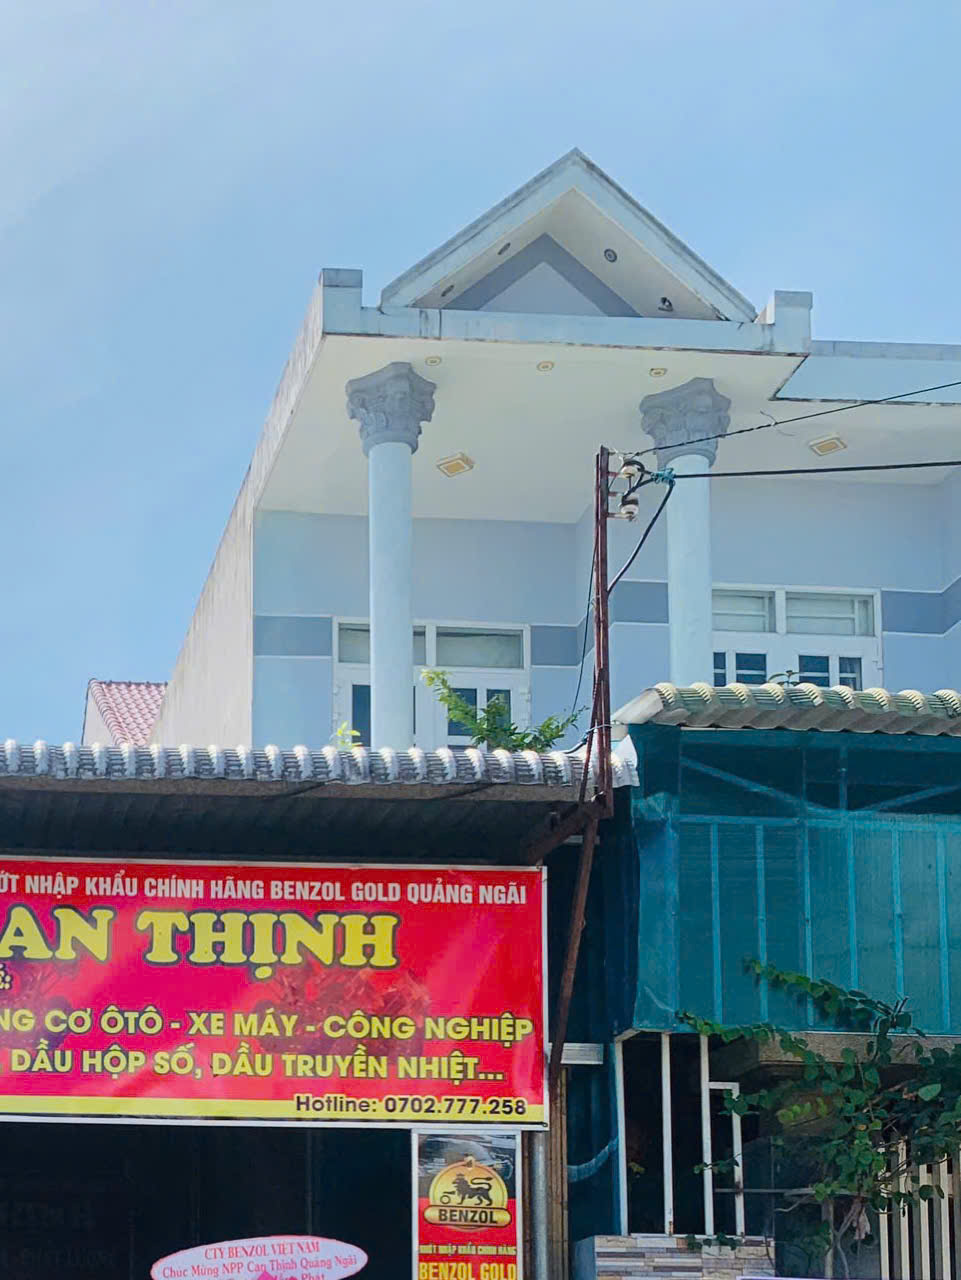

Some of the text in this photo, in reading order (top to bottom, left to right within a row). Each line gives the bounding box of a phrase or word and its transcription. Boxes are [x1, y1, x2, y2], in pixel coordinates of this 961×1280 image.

[25, 871, 79, 900] NHẬP
[85, 868, 138, 898] KHẨU
[144, 872, 204, 899] CHÍNH
[210, 876, 264, 900] HÃNG
[271, 880, 345, 901] BENZOL
[351, 881, 401, 902] GOLD
[407, 878, 473, 905] QUẢNG
[479, 882, 526, 904] NGÃI
[137, 909, 399, 979] THỊNH
[44, 1007, 92, 1034] CƠ
[100, 1006, 163, 1035] ÔTÔ
[188, 1012, 224, 1036] XE
[234, 1008, 298, 1037] MÁY
[323, 1010, 416, 1040] CÔNG
[424, 1012, 533, 1048] NGHIỆP
[11, 1038, 73, 1073] DẦU
[82, 1044, 146, 1080] HỘP
[154, 1043, 202, 1079] SỐ,
[212, 1041, 273, 1077] DẦU
[282, 1044, 388, 1080] TRUYỀN
[295, 1095, 527, 1116] Hotline: 0702.777.258
[439, 1209, 497, 1224] BENZOL
[228, 1244, 268, 1259] BENZOL
[223, 1261, 243, 1274] NPP
[419, 1262, 476, 1280] BENZOL
